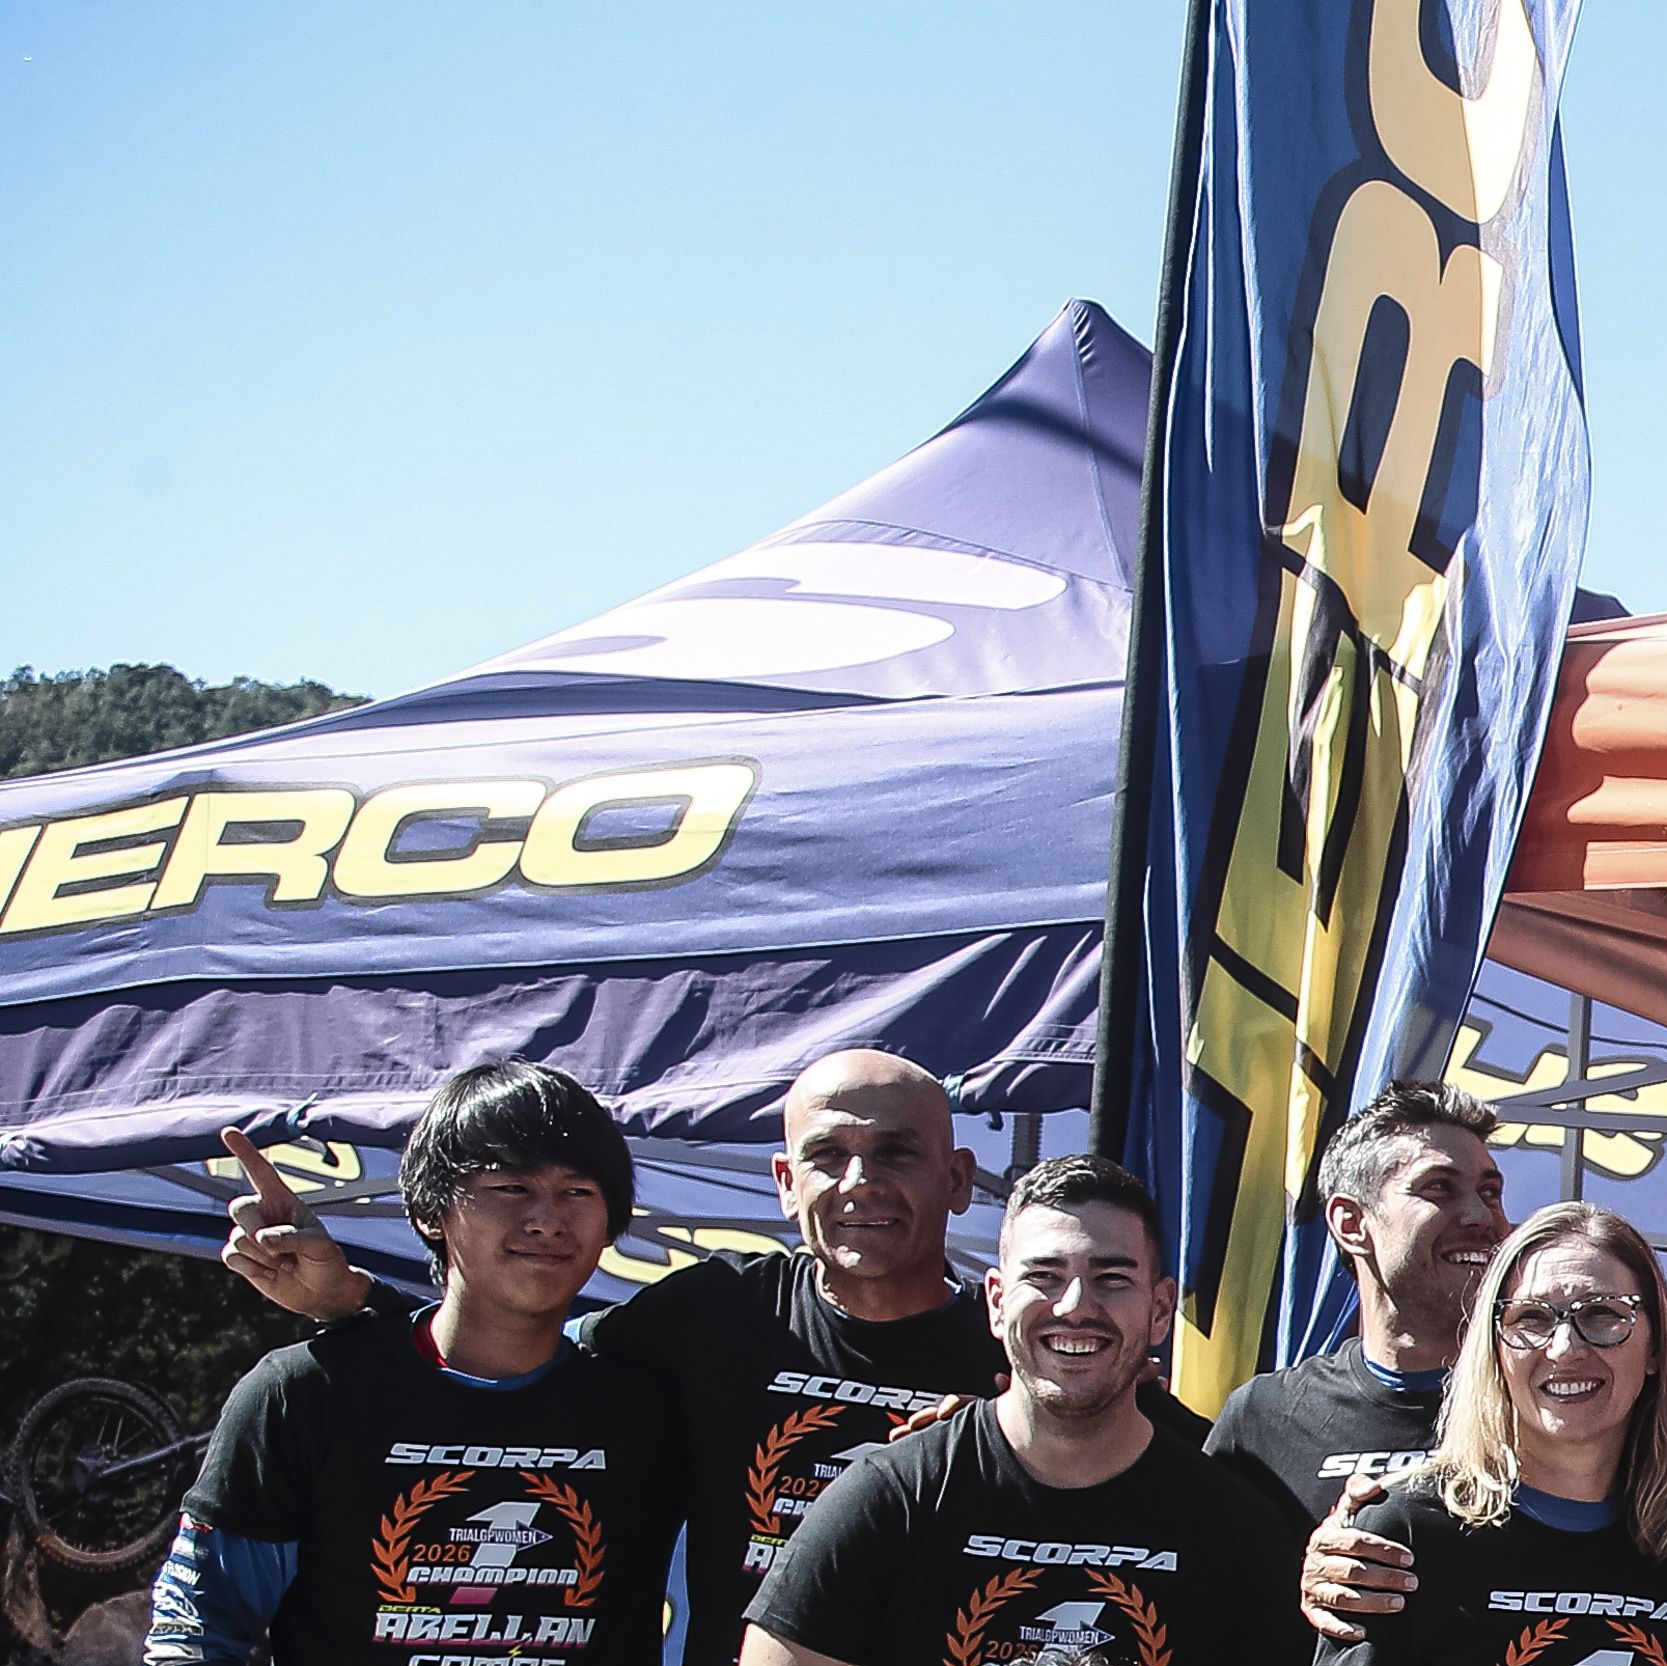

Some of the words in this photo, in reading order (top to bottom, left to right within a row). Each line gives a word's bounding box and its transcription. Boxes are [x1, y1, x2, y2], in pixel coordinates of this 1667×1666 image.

[385, 1443, 606, 1470] SCORPA
[779, 1475, 822, 1497] 202
[449, 1527, 537, 1545] TRIALGPWOMEN
[413, 1544, 471, 1562] 2026
[964, 1535, 1178, 1572] SCORPA
[407, 1566, 579, 1588] CHAMPION
[373, 1613, 595, 1648] ABELLAN
[1019, 1627, 1099, 1646] TRIALGPWOMEN
